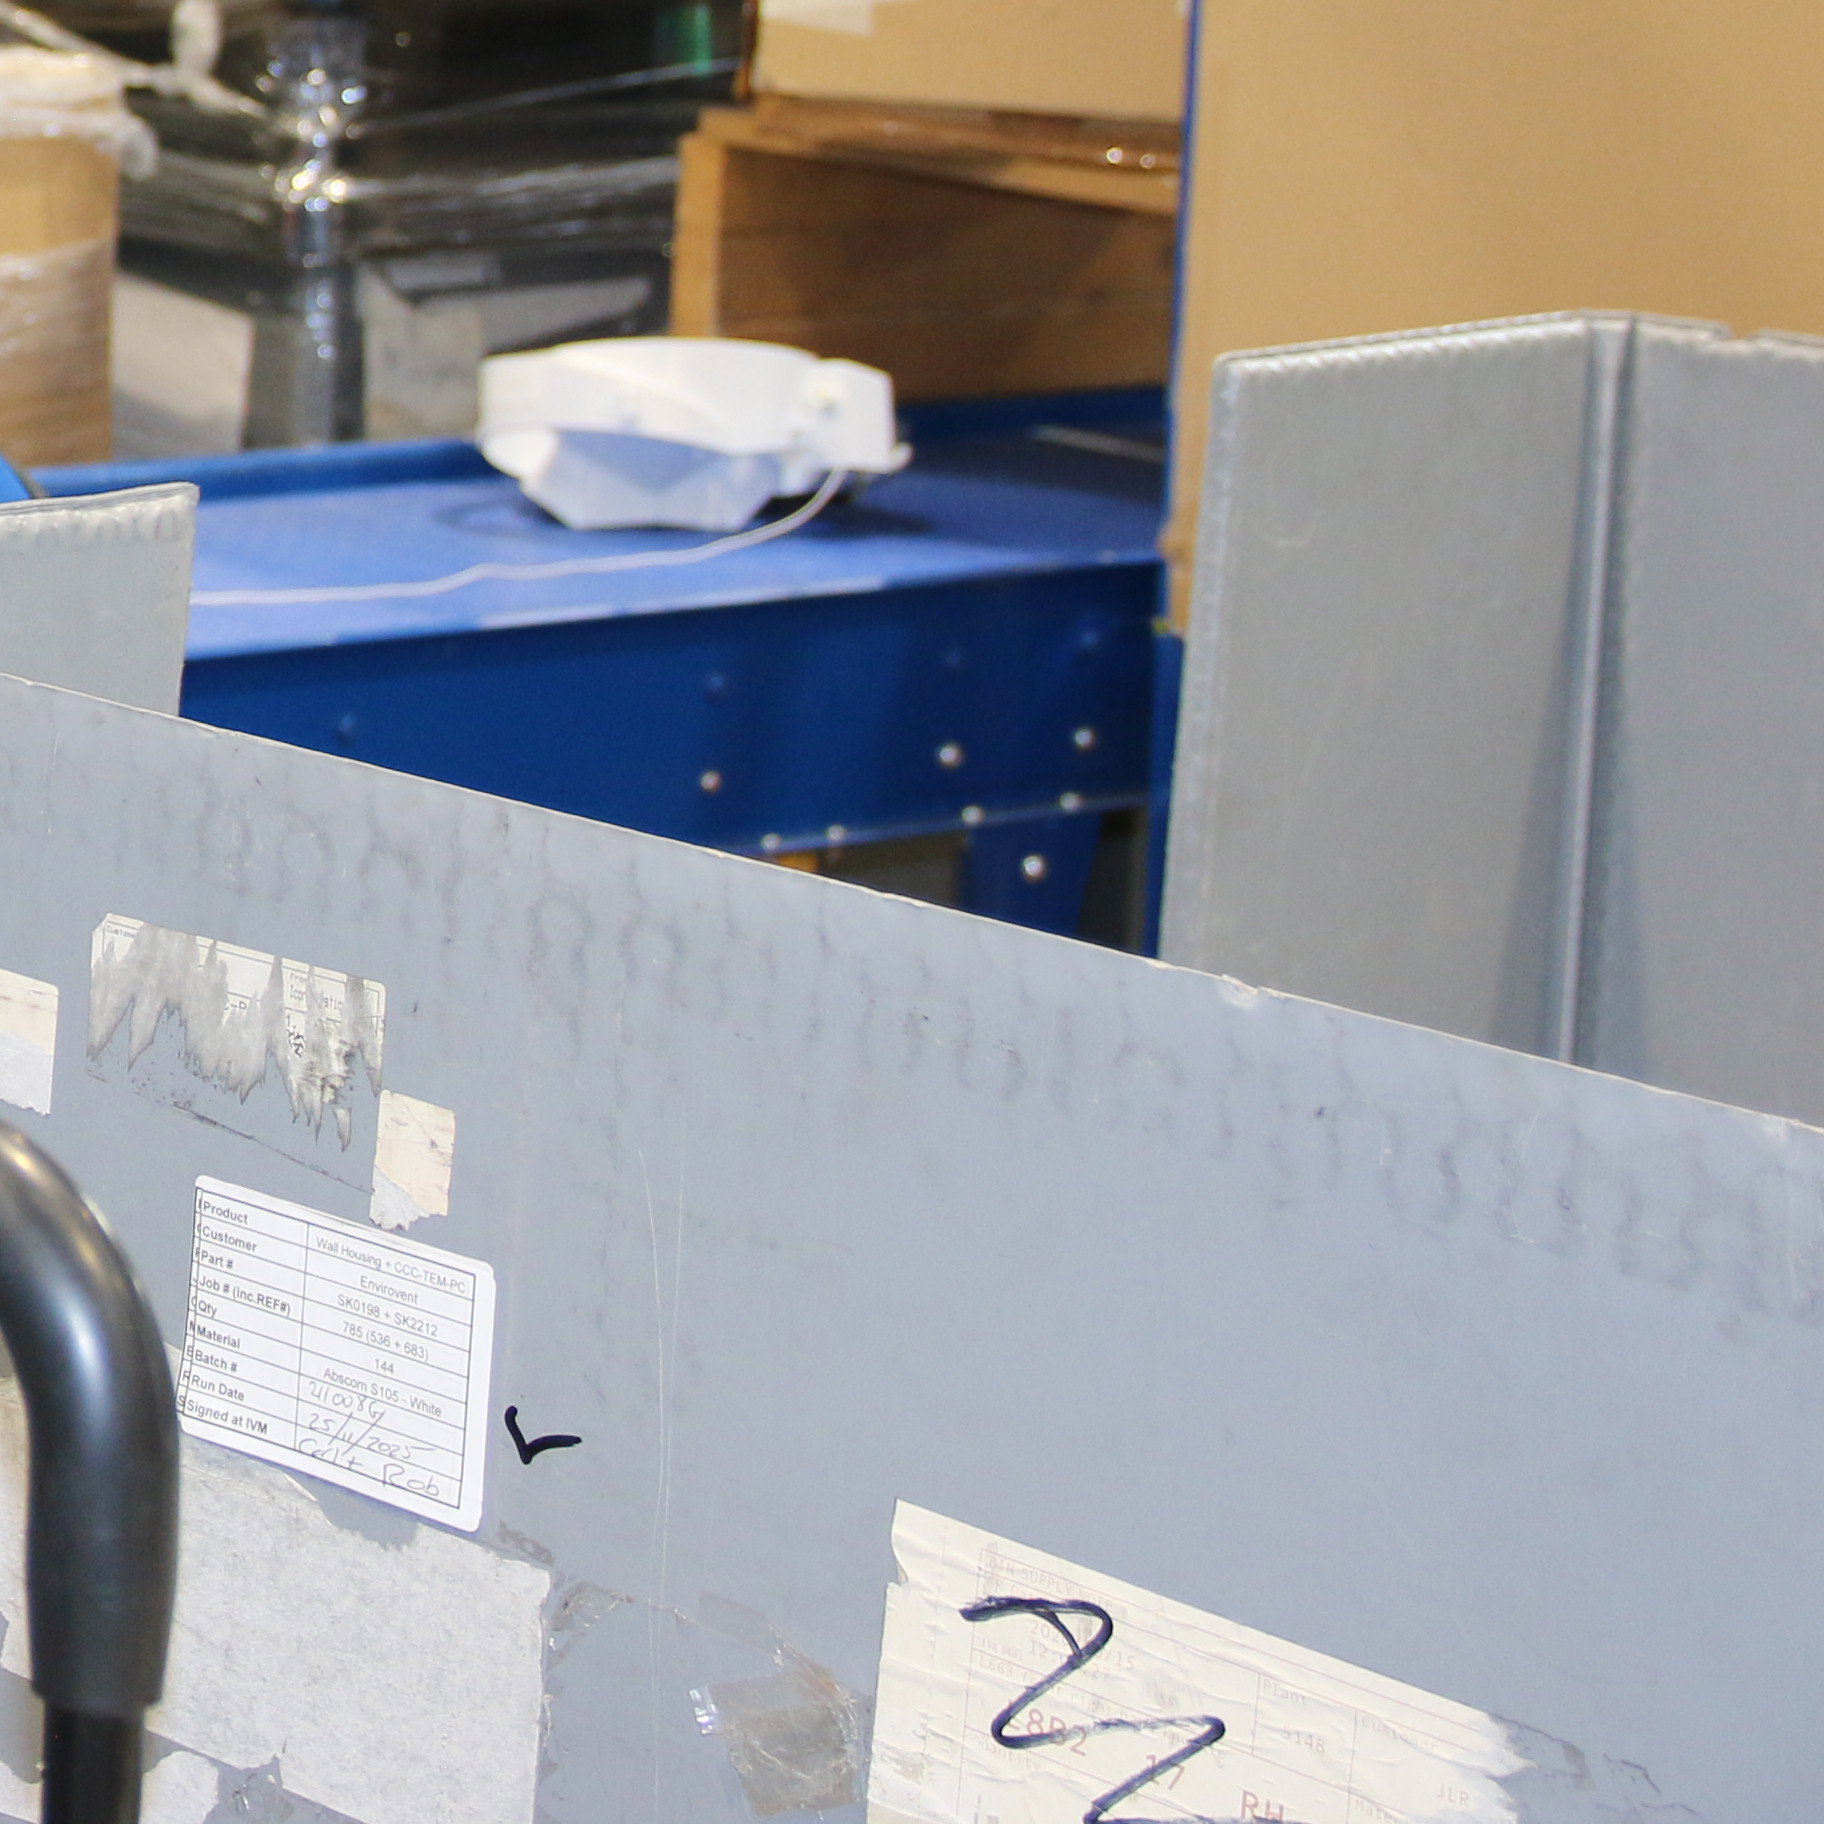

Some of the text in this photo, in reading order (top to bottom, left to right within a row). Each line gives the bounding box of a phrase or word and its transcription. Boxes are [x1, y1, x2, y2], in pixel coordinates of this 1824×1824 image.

[203, 1201, 248, 1225] Product
[202, 1226, 258, 1252] Customer
[201, 1250, 234, 1269] Part #
[315, 1236, 339, 1252] Wall
[341, 1245, 382, 1271] Housing
[393, 1260, 467, 1294] CCC-TEM-PC
[198, 1276, 220, 1291] Job
[222, 1283, 230, 1293] #
[359, 1275, 419, 1304] Envirovent
[197, 1300, 218, 1319] Qty
[337, 1293, 380, 1318] SK0198
[393, 1311, 439, 1337] SK2212
[197, 1325, 241, 1349] Material
[342, 1321, 363, 1338] 785
[365, 1329, 391, 1348] (536
[403, 1340, 429, 1362] 683)
[194, 1349, 238, 1372] Batch #
[374, 1358, 395, 1374] 144
[191, 1374, 245, 1402] Run Date
[323, 1367, 368, 1392] Abscom
[370, 1383, 400, 1403] S105
[409, 1395, 443, 1416] White
[186, 1399, 268, 1435] Signed at IVM
[1435, 1782, 1470, 1809] JLR
